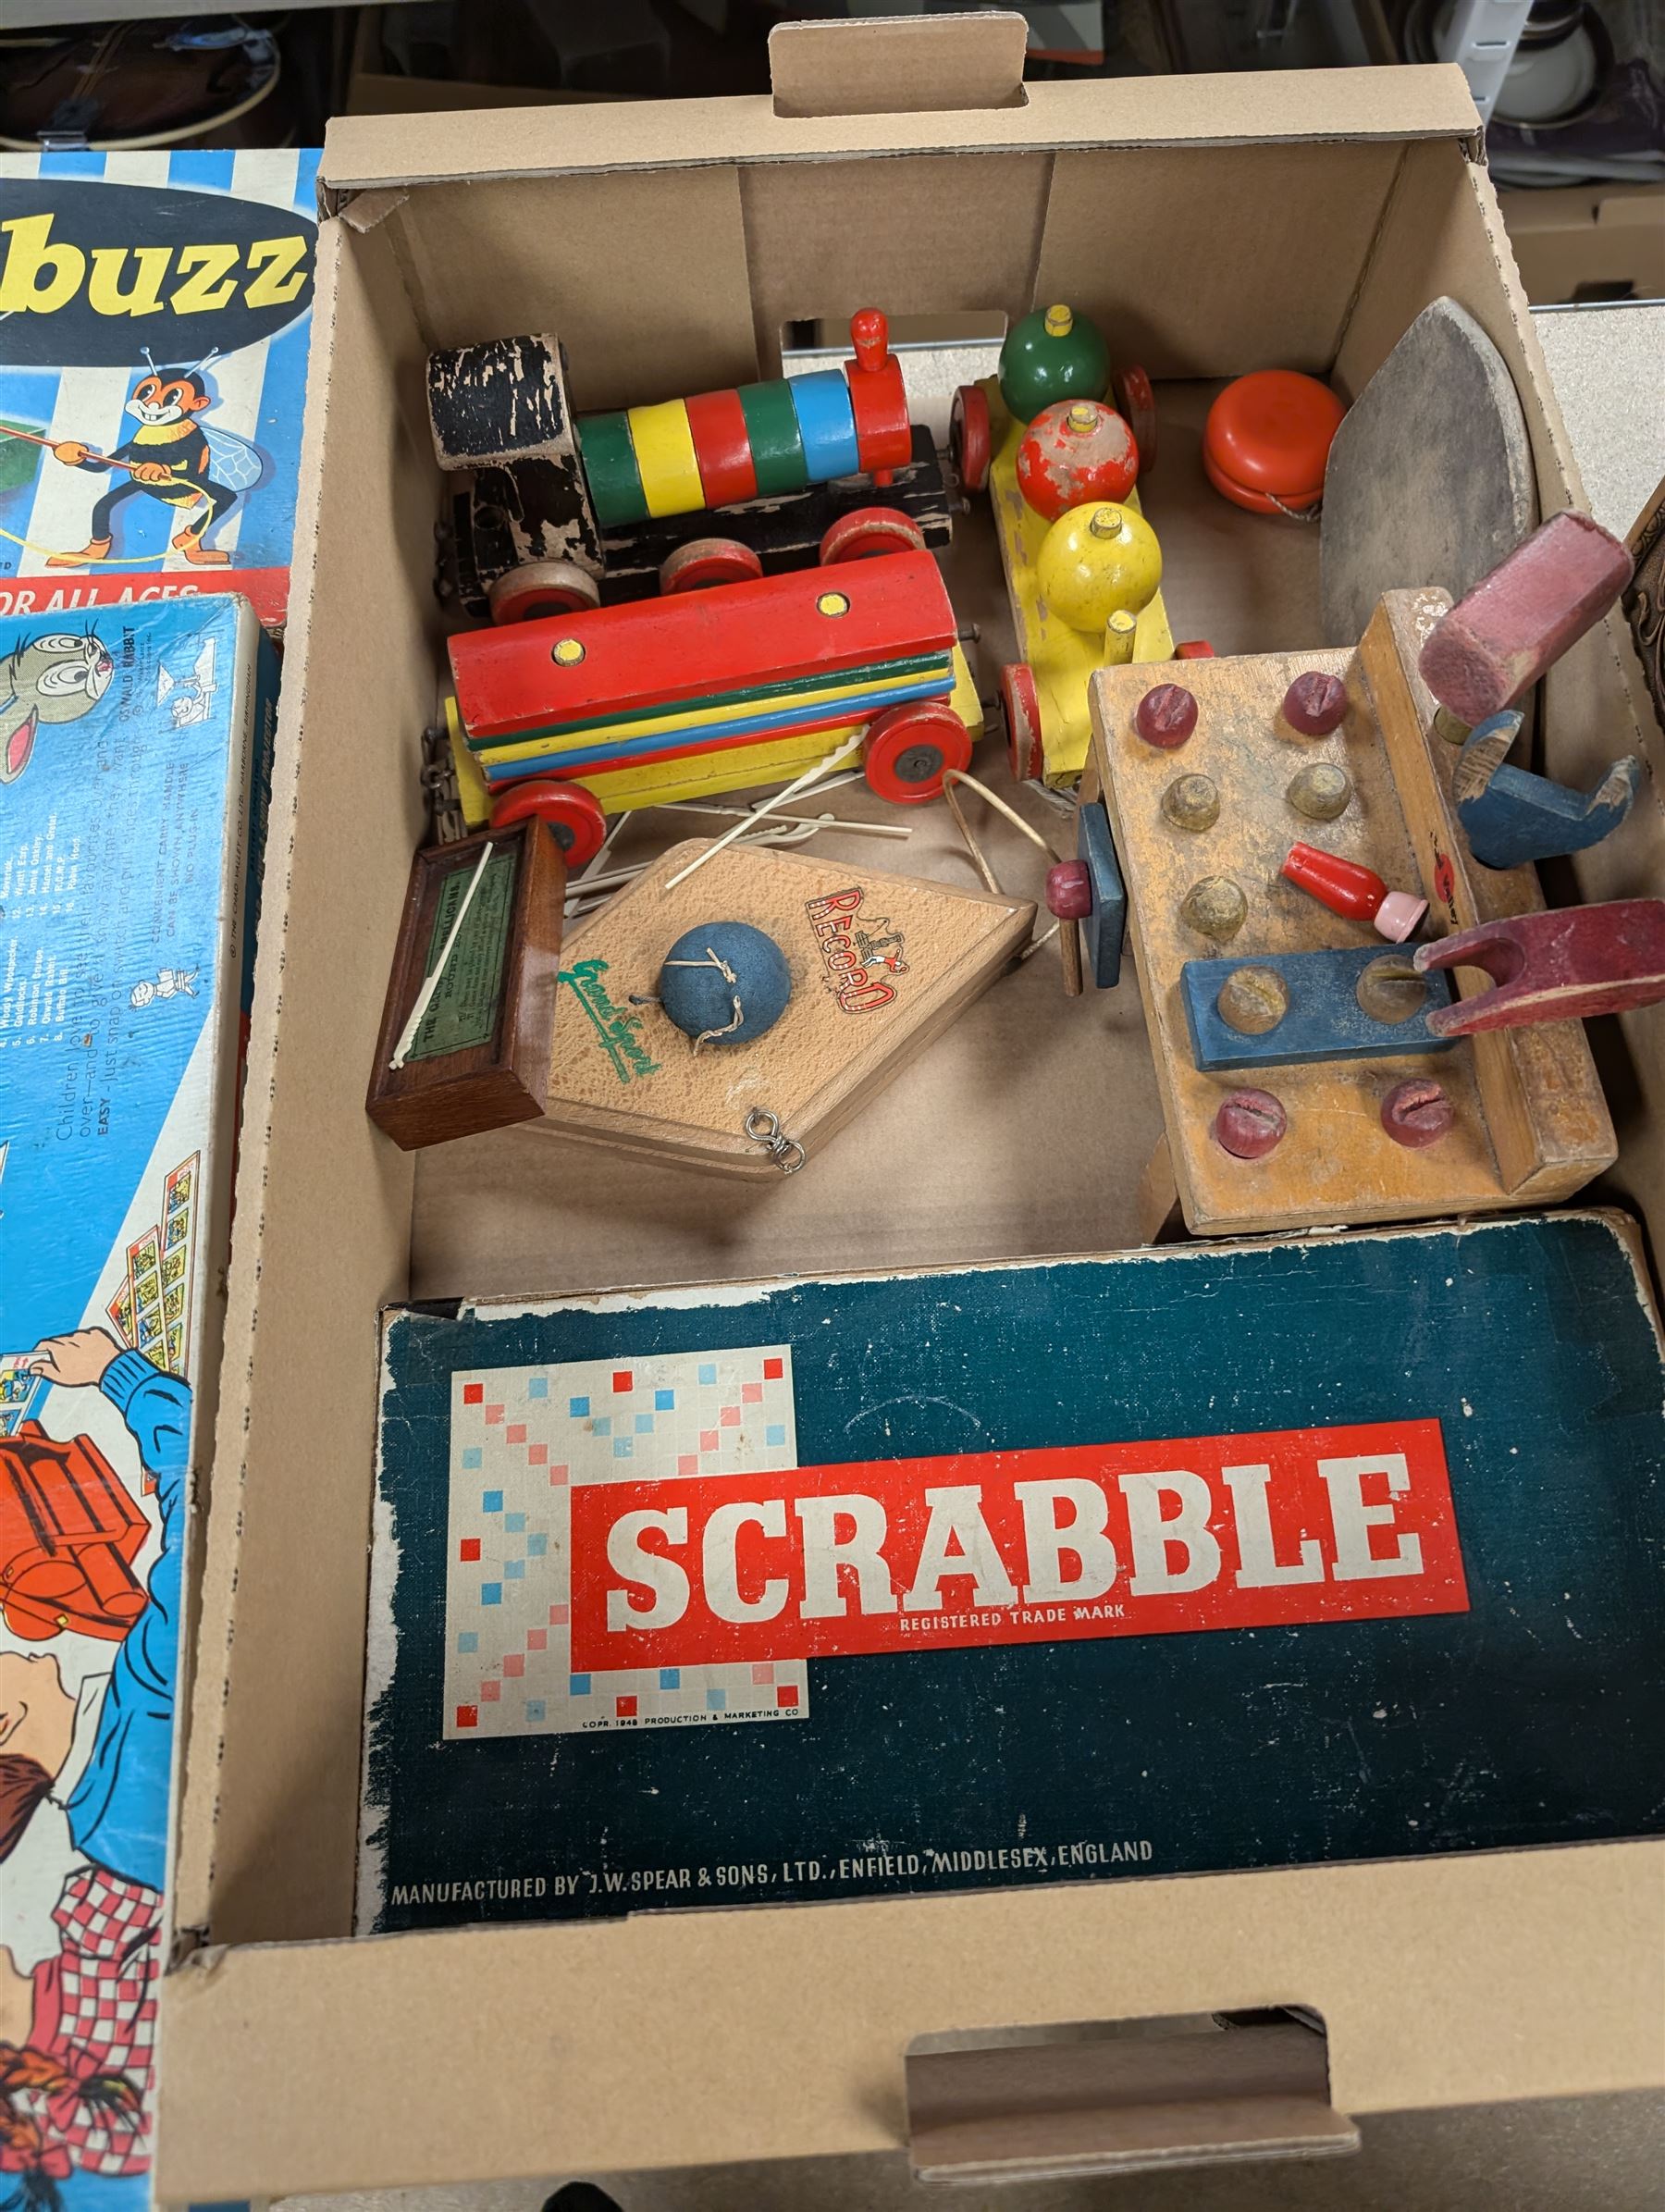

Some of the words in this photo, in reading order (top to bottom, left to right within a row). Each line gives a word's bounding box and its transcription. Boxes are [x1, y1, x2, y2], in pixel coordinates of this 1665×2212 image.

[0, 213, 308, 317] buzz
[122, 625, 135, 668] RABBIT
[118, 675, 133, 722] OSWALD
[163, 760, 175, 811] HANDLE
[176, 762, 189, 831] ANYWHERE
[44, 844, 55, 860] and
[158, 818, 170, 855] CARRY
[170, 836, 184, 885] SHOWN
[184, 864, 195, 884] NO
[151, 860, 166, 944] CONVENIENT
[168, 890, 178, 905] BE
[166, 910, 177, 938] CAN
[807, 888, 895, 1013] RECORD
[41, 992, 53, 1024] Oswald
[56, 989, 68, 1022] Buffalo
[73, 987, 85, 1005] to
[89, 973, 108, 1007] give
[64, 1016, 83, 1052] love
[88, 1018, 101, 1036] to
[423, 1019, 437, 1044] THE
[97, 1097, 111, 1136] EASY
[106, 1007, 123, 1044] snap
[56, 1061, 80, 1142] Children
[606, 1453, 1424, 1633] SCRABBLE
[900, 1612, 1002, 1631] REGISTERED
[1009, 1609, 1067, 1625] TRADE
[1073, 1604, 1125, 1620] MARK
[645, 1714, 707, 1725] PRODUCTION
[724, 1710, 780, 1720] MARKETING
[390, 1877, 547, 1906] MANUFACTURED
[554, 1875, 579, 1896] BY
[697, 1867, 712, 1886] &
[1058, 1840, 1153, 1867] ENGLAND
